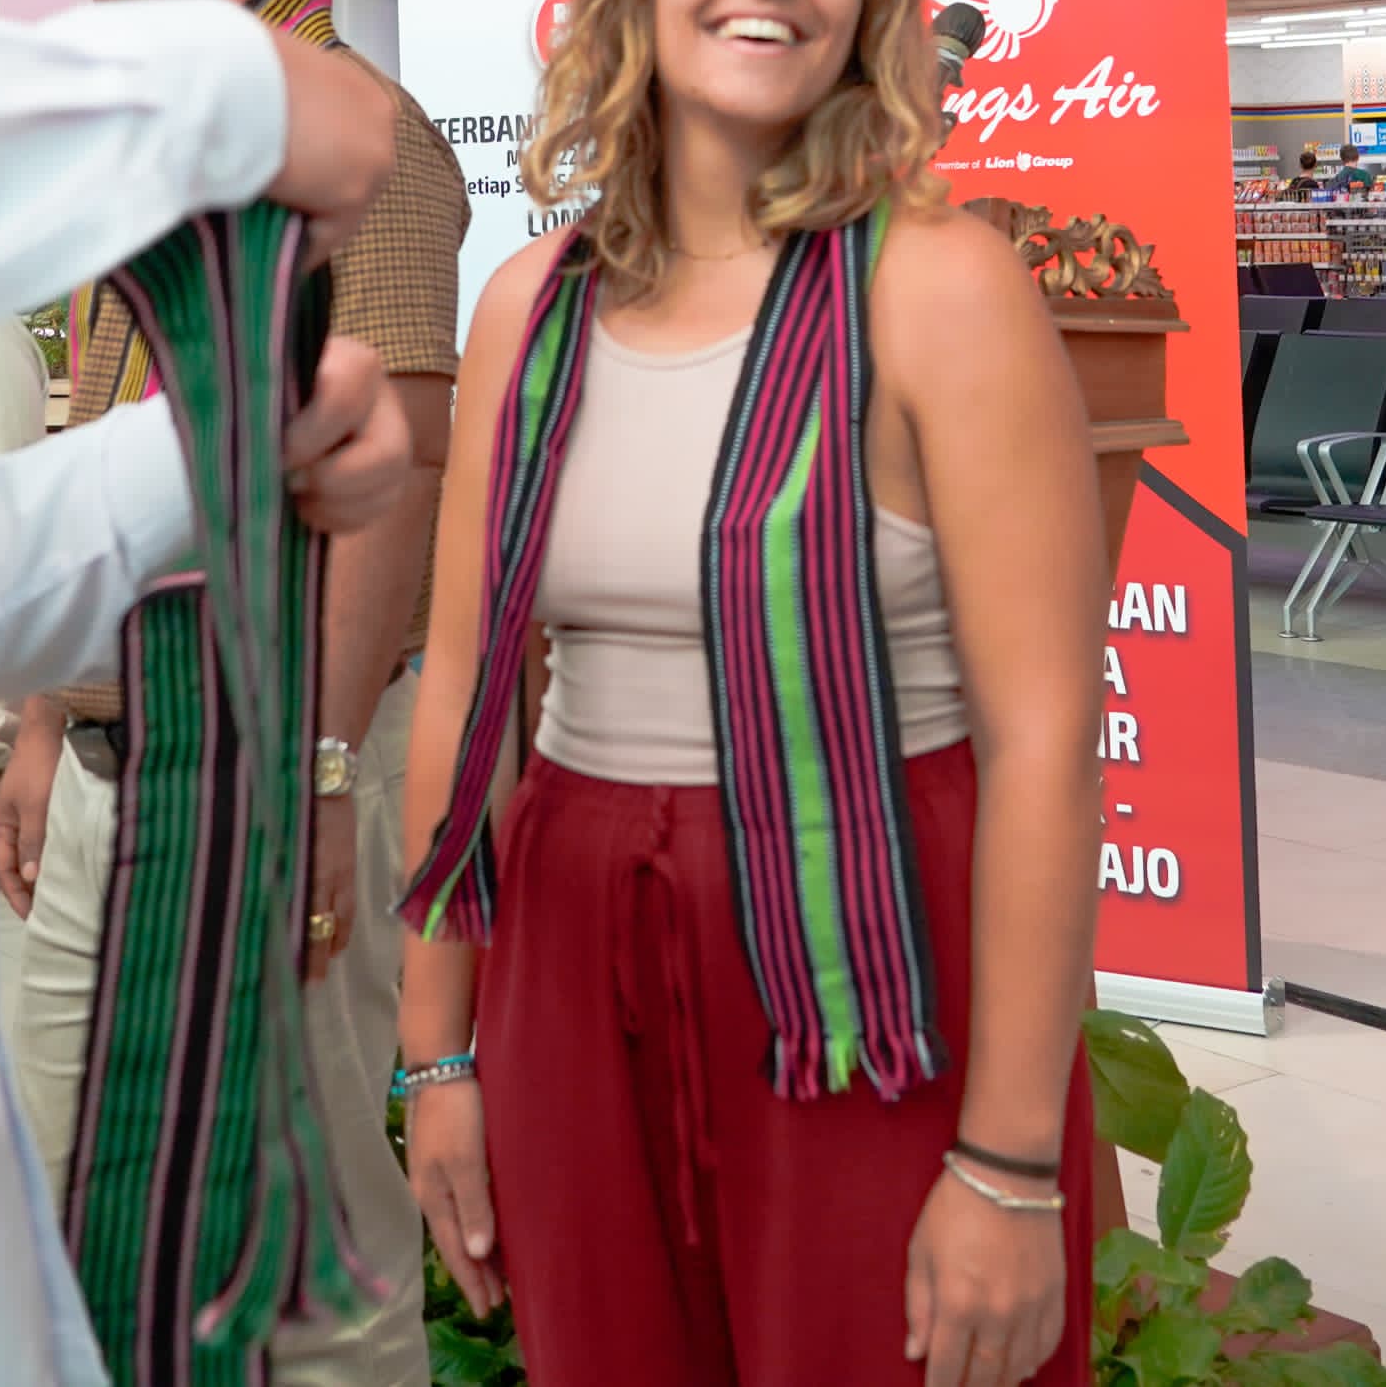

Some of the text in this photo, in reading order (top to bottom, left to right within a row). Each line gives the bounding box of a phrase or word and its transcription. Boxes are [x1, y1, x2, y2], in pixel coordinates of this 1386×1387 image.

[1049, 55, 1161, 125] Air
[934, 161, 970, 171] member
[985, 157, 1015, 169] Lion
[1032, 155, 1074, 169] Group
